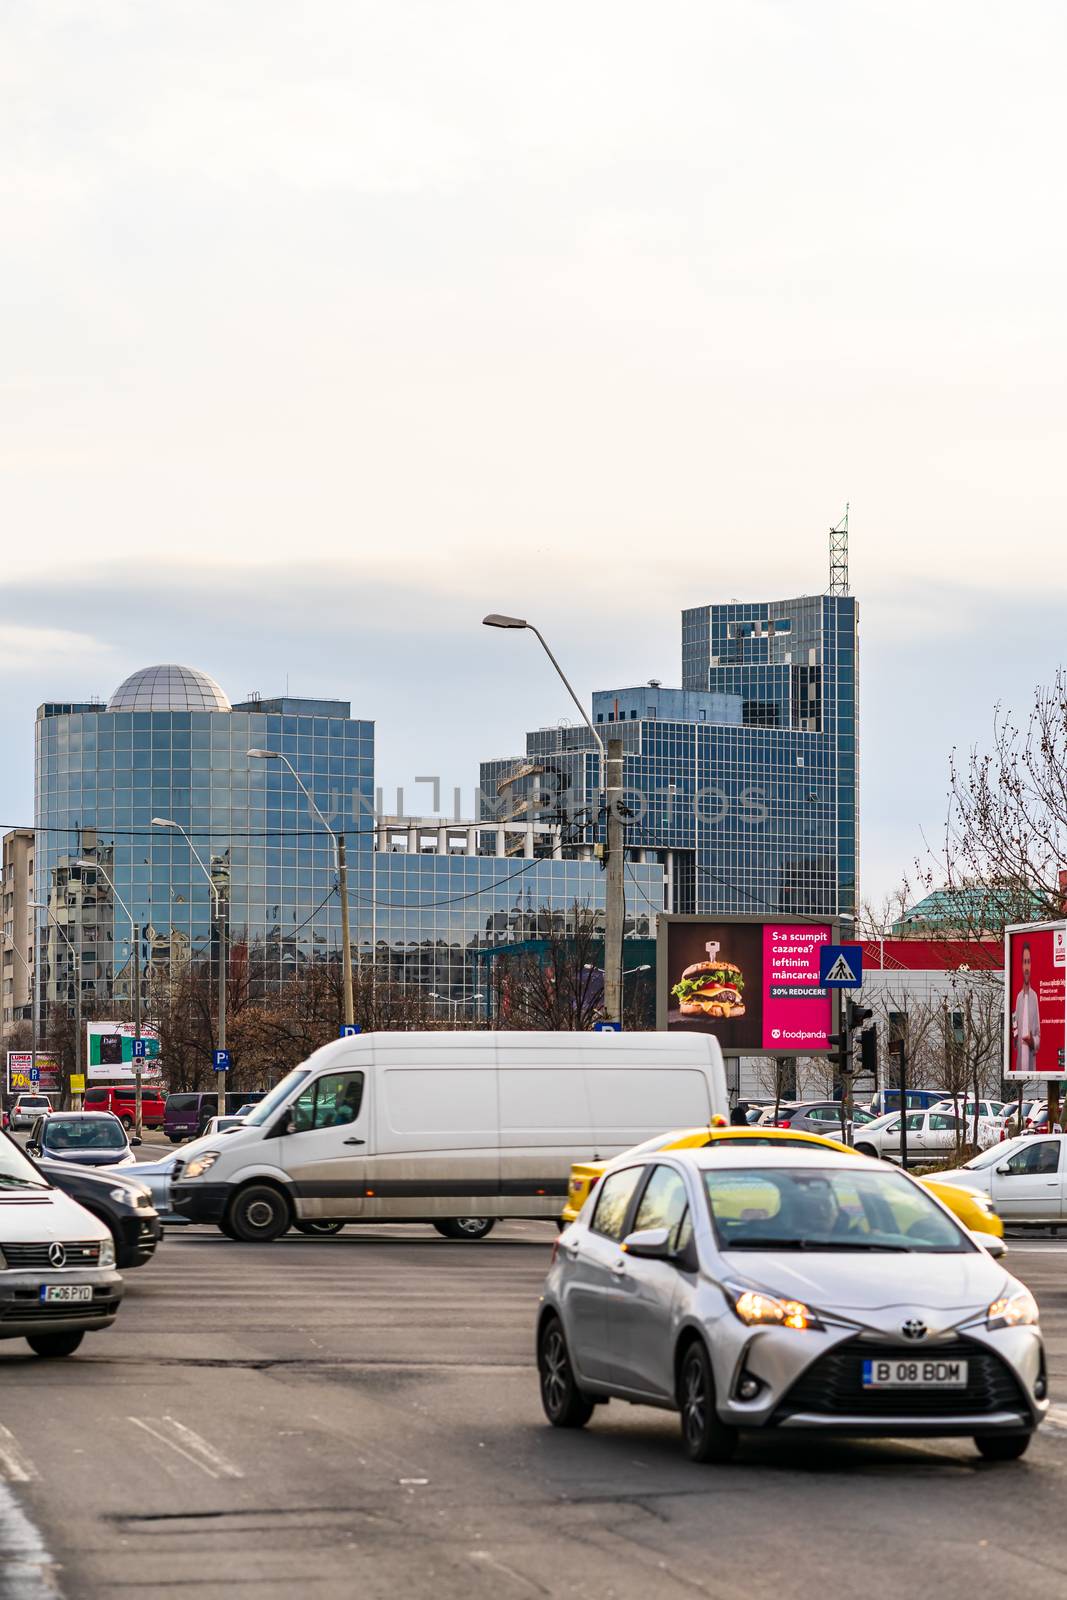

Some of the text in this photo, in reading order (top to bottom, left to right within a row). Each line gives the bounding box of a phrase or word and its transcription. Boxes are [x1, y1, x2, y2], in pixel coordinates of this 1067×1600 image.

[772, 932, 828, 943] S-a scumpit
[772, 944, 814, 953] cazarea?
[772, 958, 810, 967] Ieftinim
[772, 988, 827, 996] 30% REDUCERE
[782, 1029, 827, 1040] foodpanda
[217, 1052, 226, 1064] P
[877, 1363, 960, 1381] B 08 BDM
